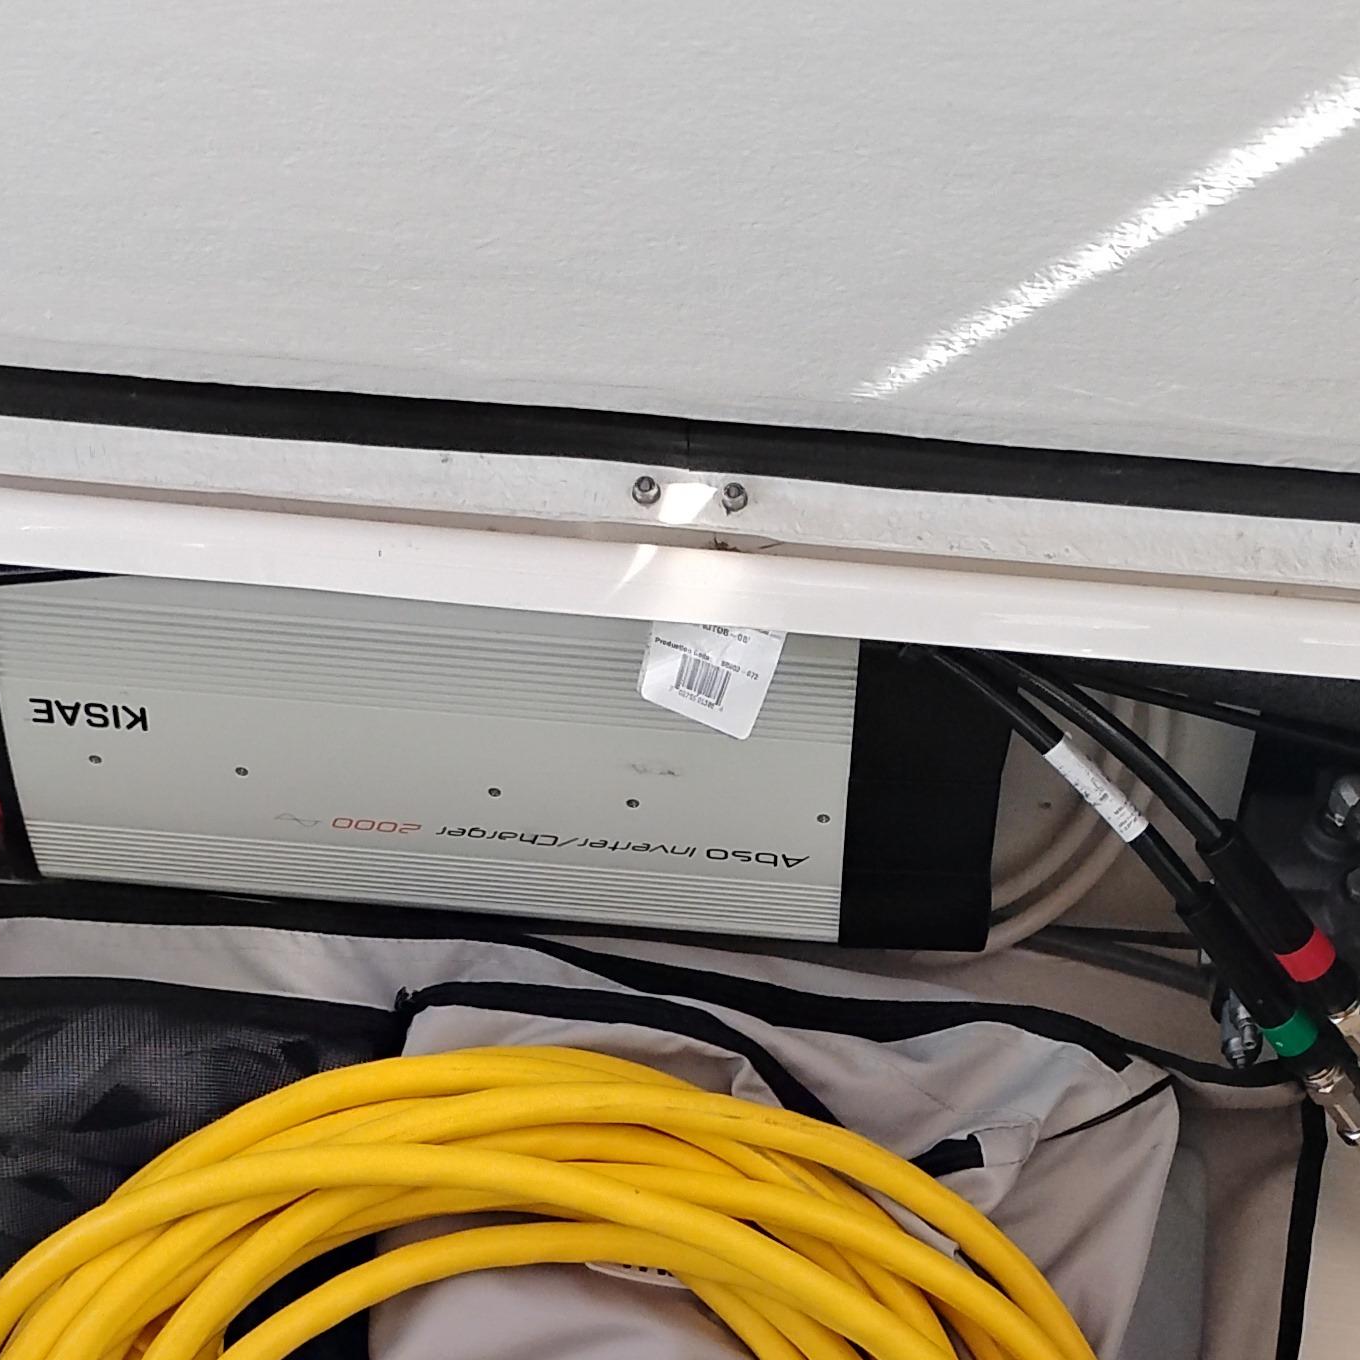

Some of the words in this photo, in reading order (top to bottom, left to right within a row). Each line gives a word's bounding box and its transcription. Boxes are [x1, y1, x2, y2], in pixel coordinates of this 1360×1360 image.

[28, 697, 149, 732] KISAE
[331, 816, 423, 835] 2000
[435, 824, 697, 858] Inverter/Charger
